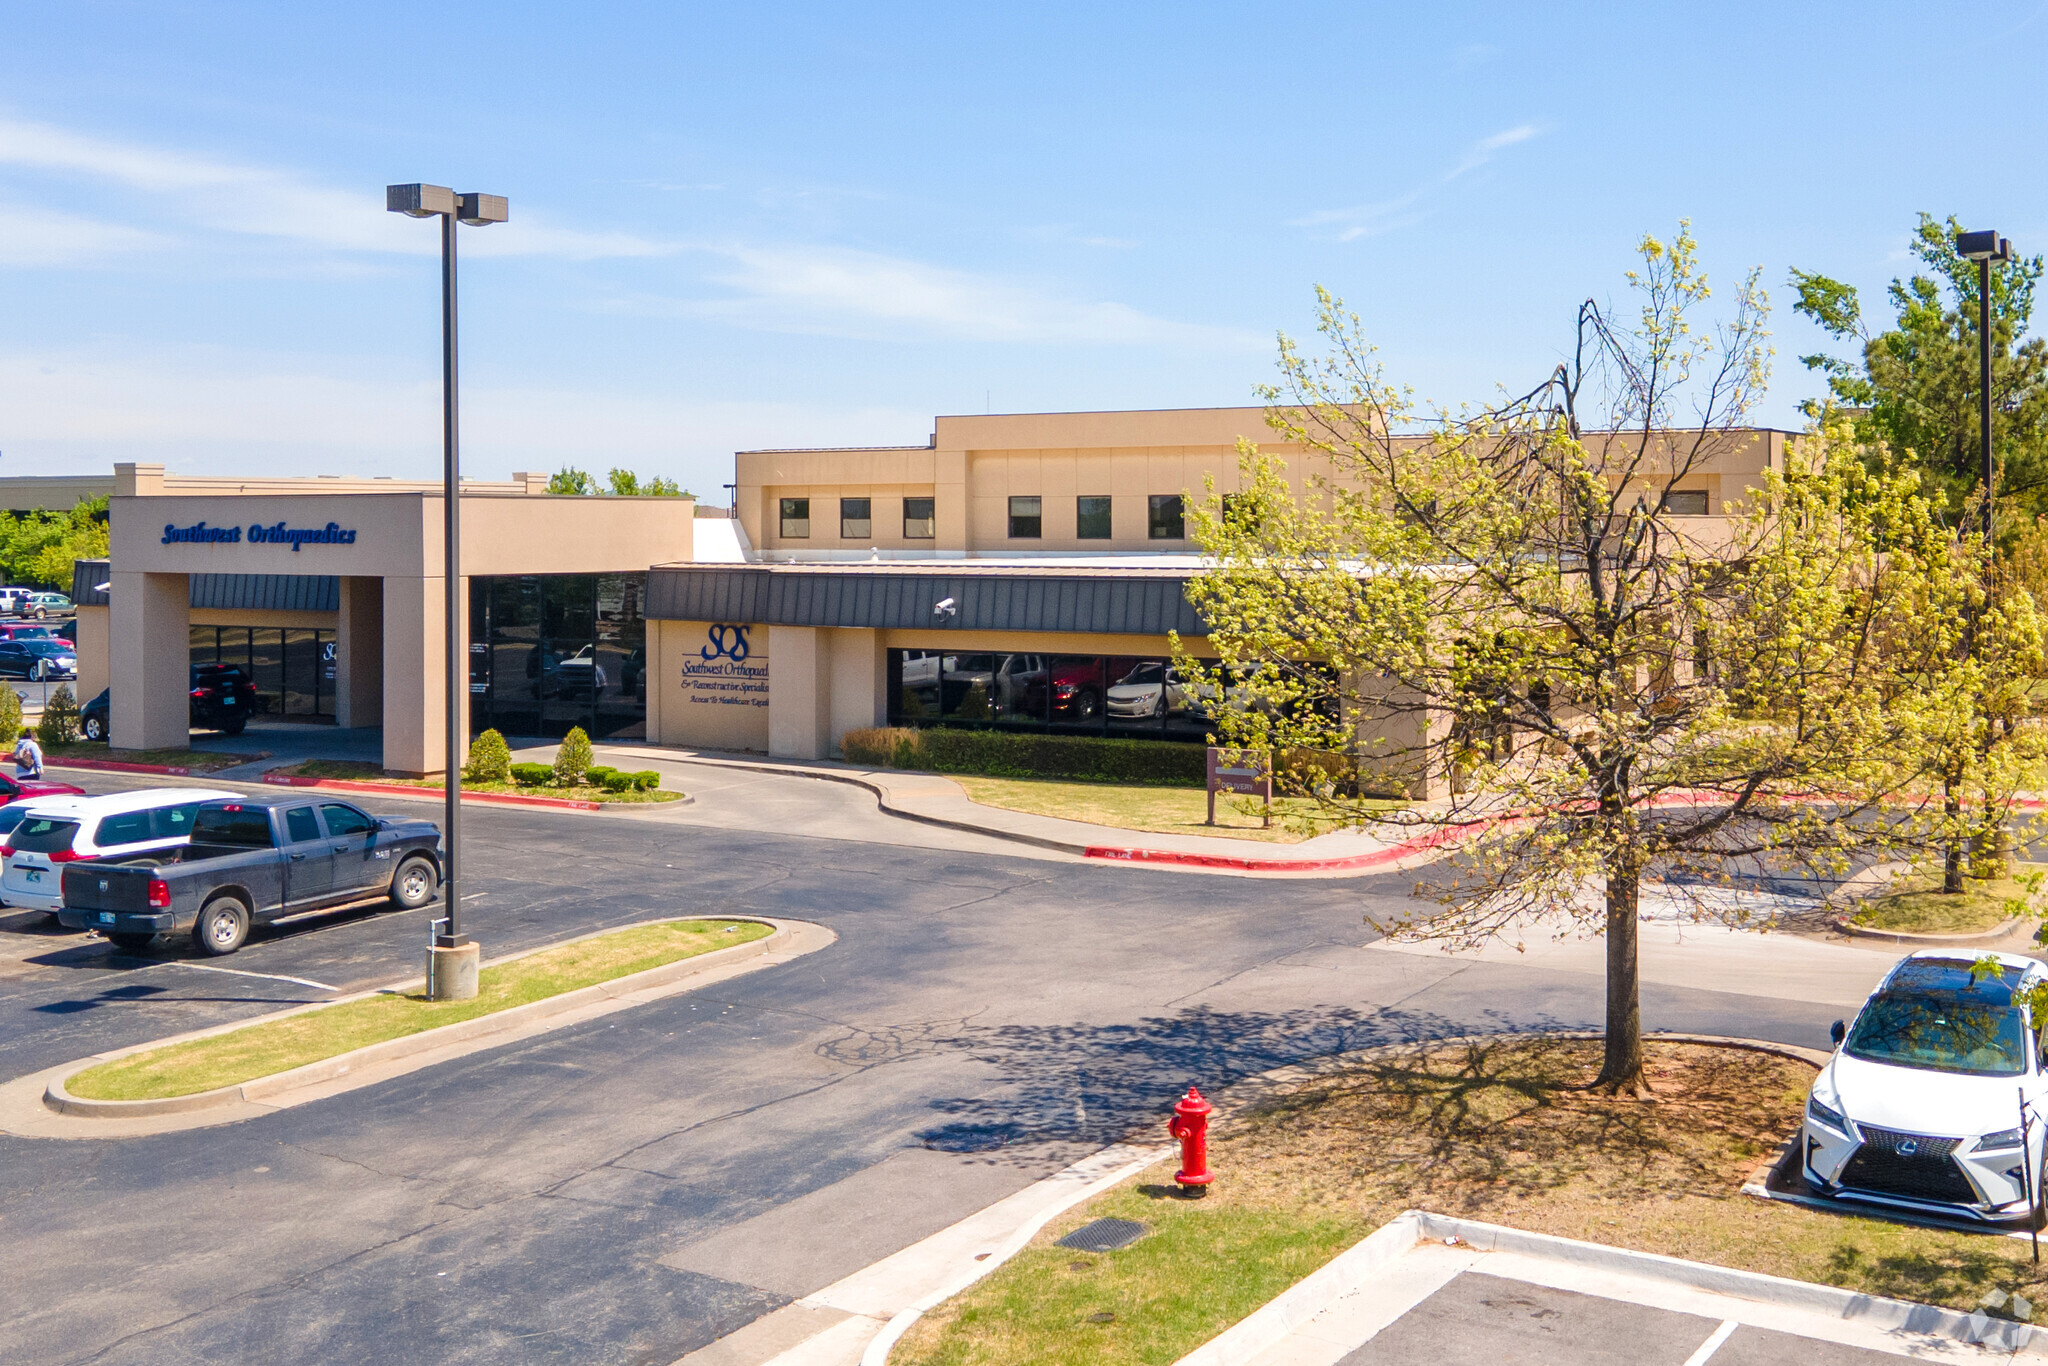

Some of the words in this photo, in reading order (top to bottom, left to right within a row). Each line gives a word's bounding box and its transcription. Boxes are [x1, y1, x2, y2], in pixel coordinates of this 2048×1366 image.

[161, 522, 242, 544] Southwest
[247, 522, 357, 551] Orthopaedics
[701, 623, 751, 662] SOS
[681, 660, 723, 675] Southwest
[724, 662, 769, 679] Orthopaed
